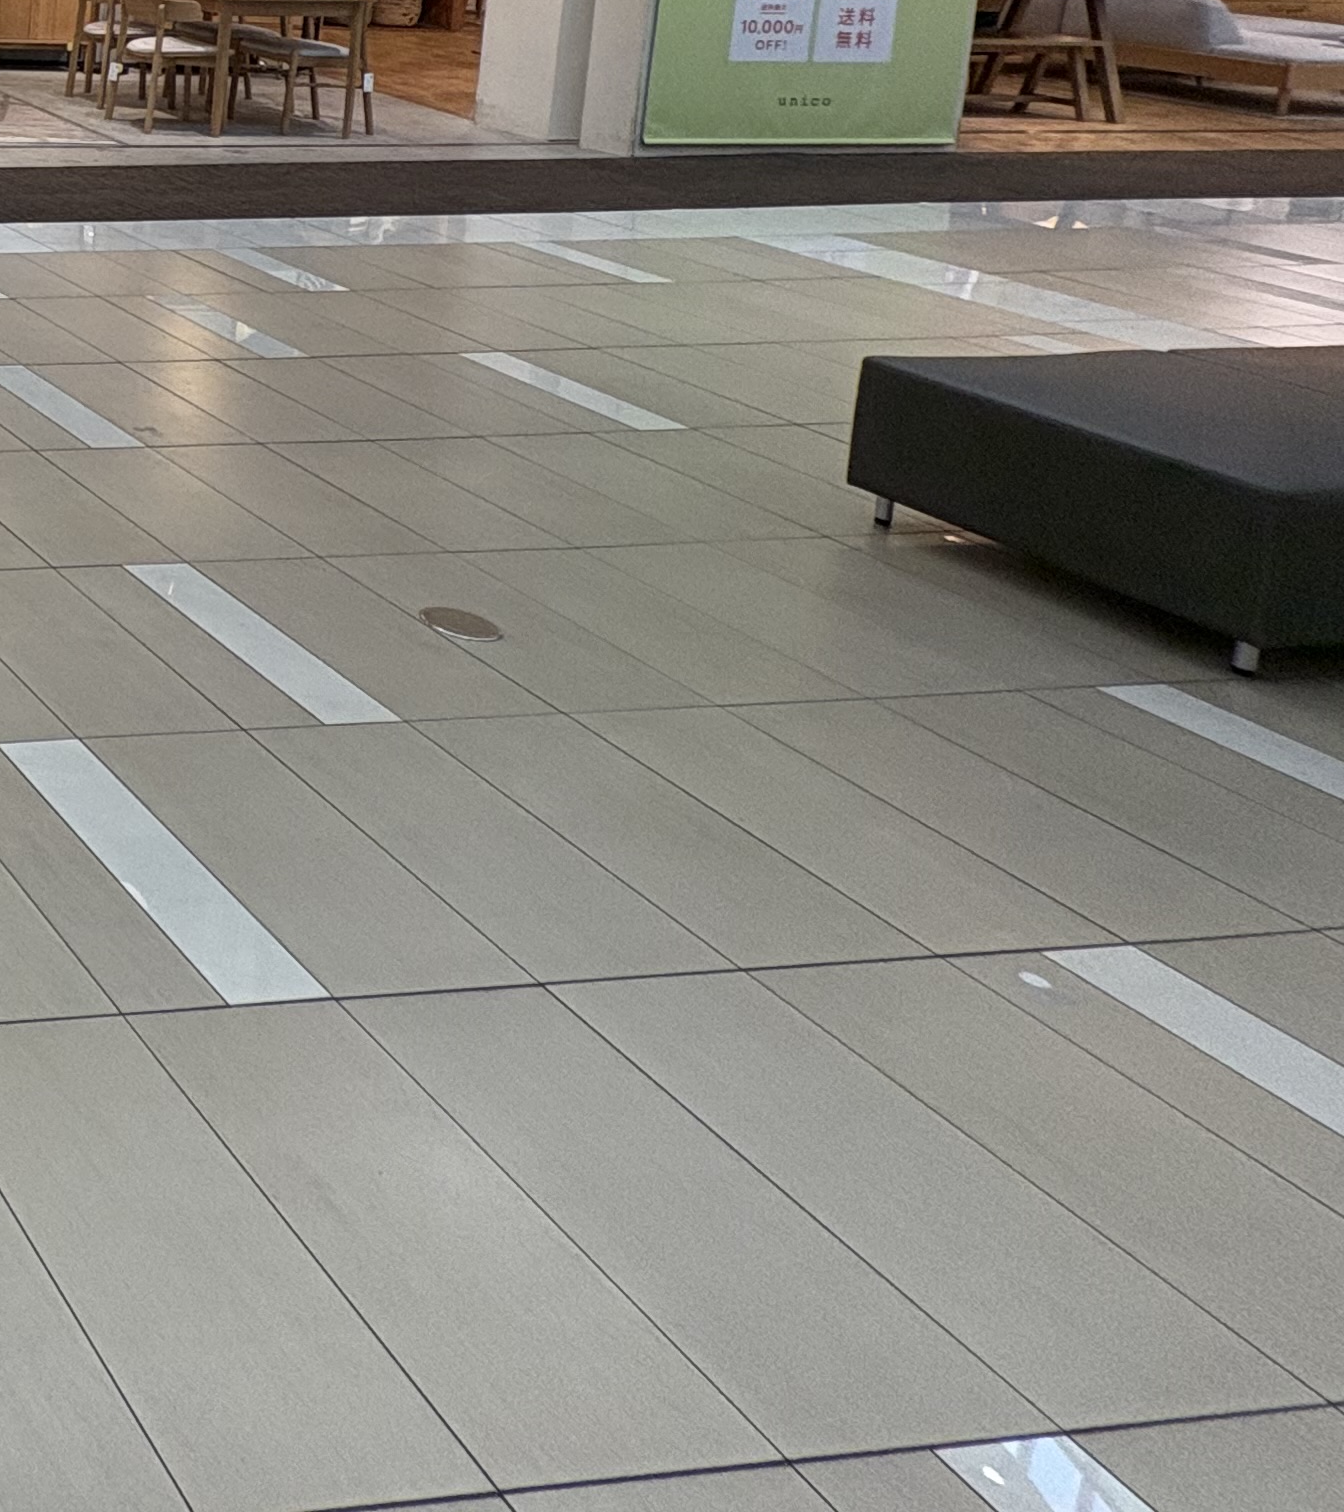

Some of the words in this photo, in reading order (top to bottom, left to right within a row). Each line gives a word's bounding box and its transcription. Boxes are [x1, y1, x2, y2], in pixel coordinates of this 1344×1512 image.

[838, 7, 876, 25] 送料
[754, 39, 788, 51] OFF!
[835, 31, 873, 49] 無料
[778, 94, 832, 107] unico
